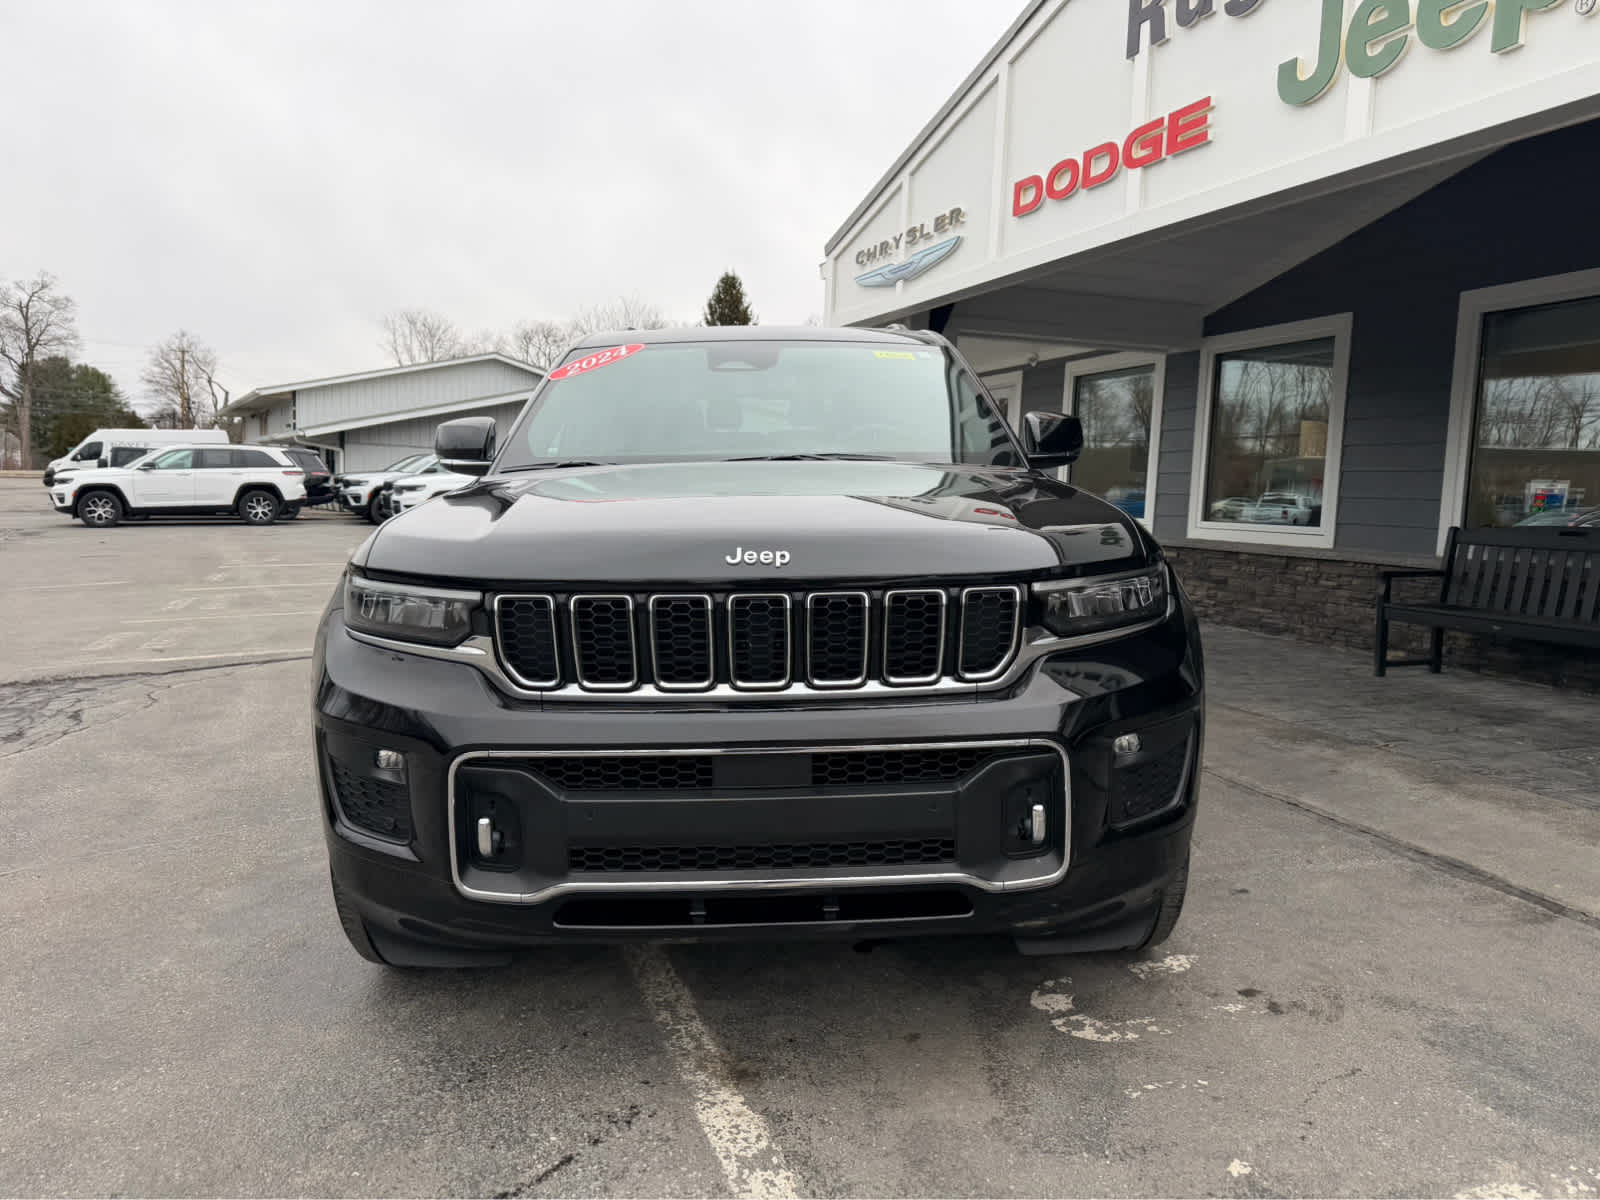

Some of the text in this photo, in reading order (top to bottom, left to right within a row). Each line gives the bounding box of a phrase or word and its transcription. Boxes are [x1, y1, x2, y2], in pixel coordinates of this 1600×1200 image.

[1277, 0, 1563, 105] Jee
[1013, 96, 1213, 217] DODGE
[856, 207, 966, 265] CHRYSLER
[567, 344, 627, 376] 2024
[725, 547, 791, 567] Jeep
